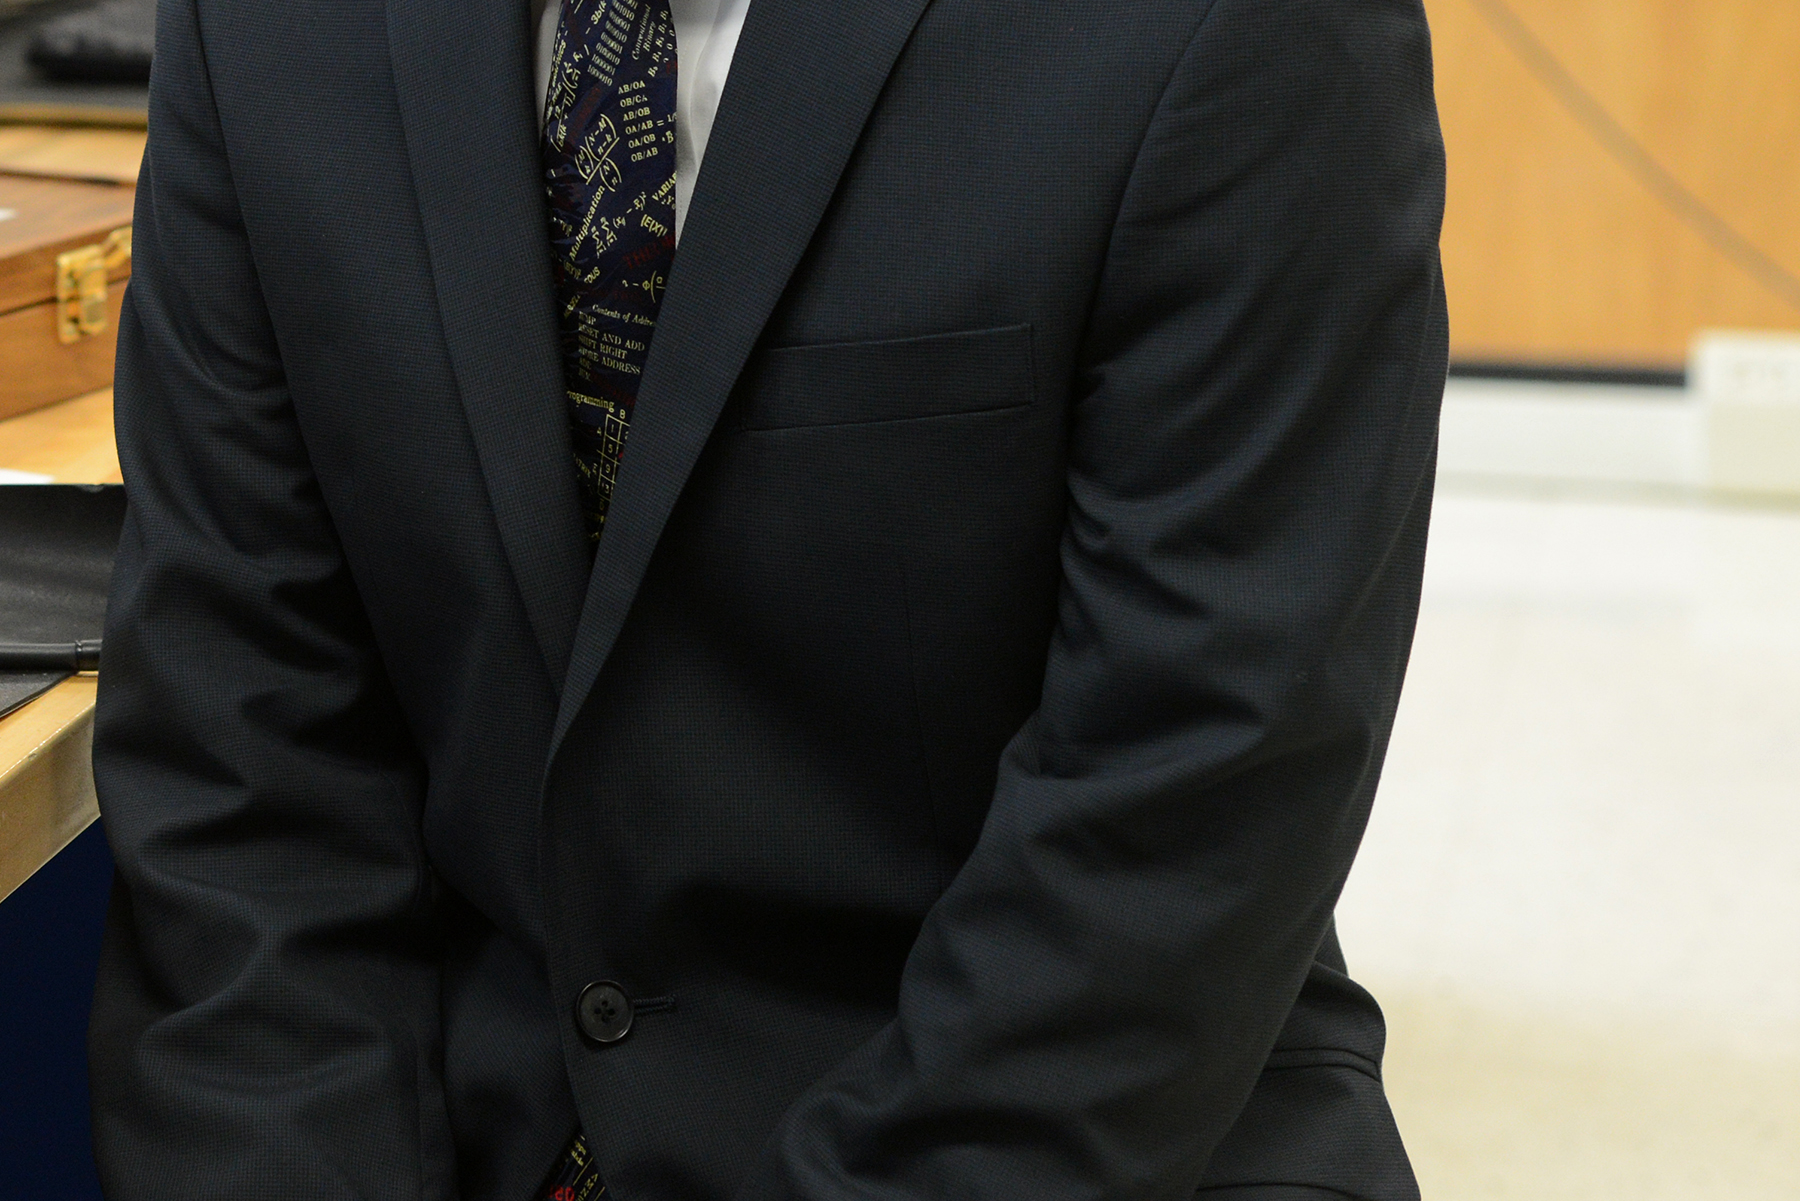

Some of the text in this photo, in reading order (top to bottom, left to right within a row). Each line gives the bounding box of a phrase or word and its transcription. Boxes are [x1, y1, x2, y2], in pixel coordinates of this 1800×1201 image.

[642, 20, 657, 53] Binary
[618, 80, 646, 94] AB/OA
[623, 106, 651, 121] AB/OB
[625, 119, 654, 135] OA/AB
[628, 133, 656, 149] OA/OB
[630, 147, 659, 162] OB/AB
[569, 185, 606, 262] Multiplication
[592, 303, 621, 320] Contents
[602, 332, 622, 345] AND
[624, 339, 646, 352] ADD
[600, 342, 628, 360] RIGHT
[601, 356, 641, 375] ADDRESS
